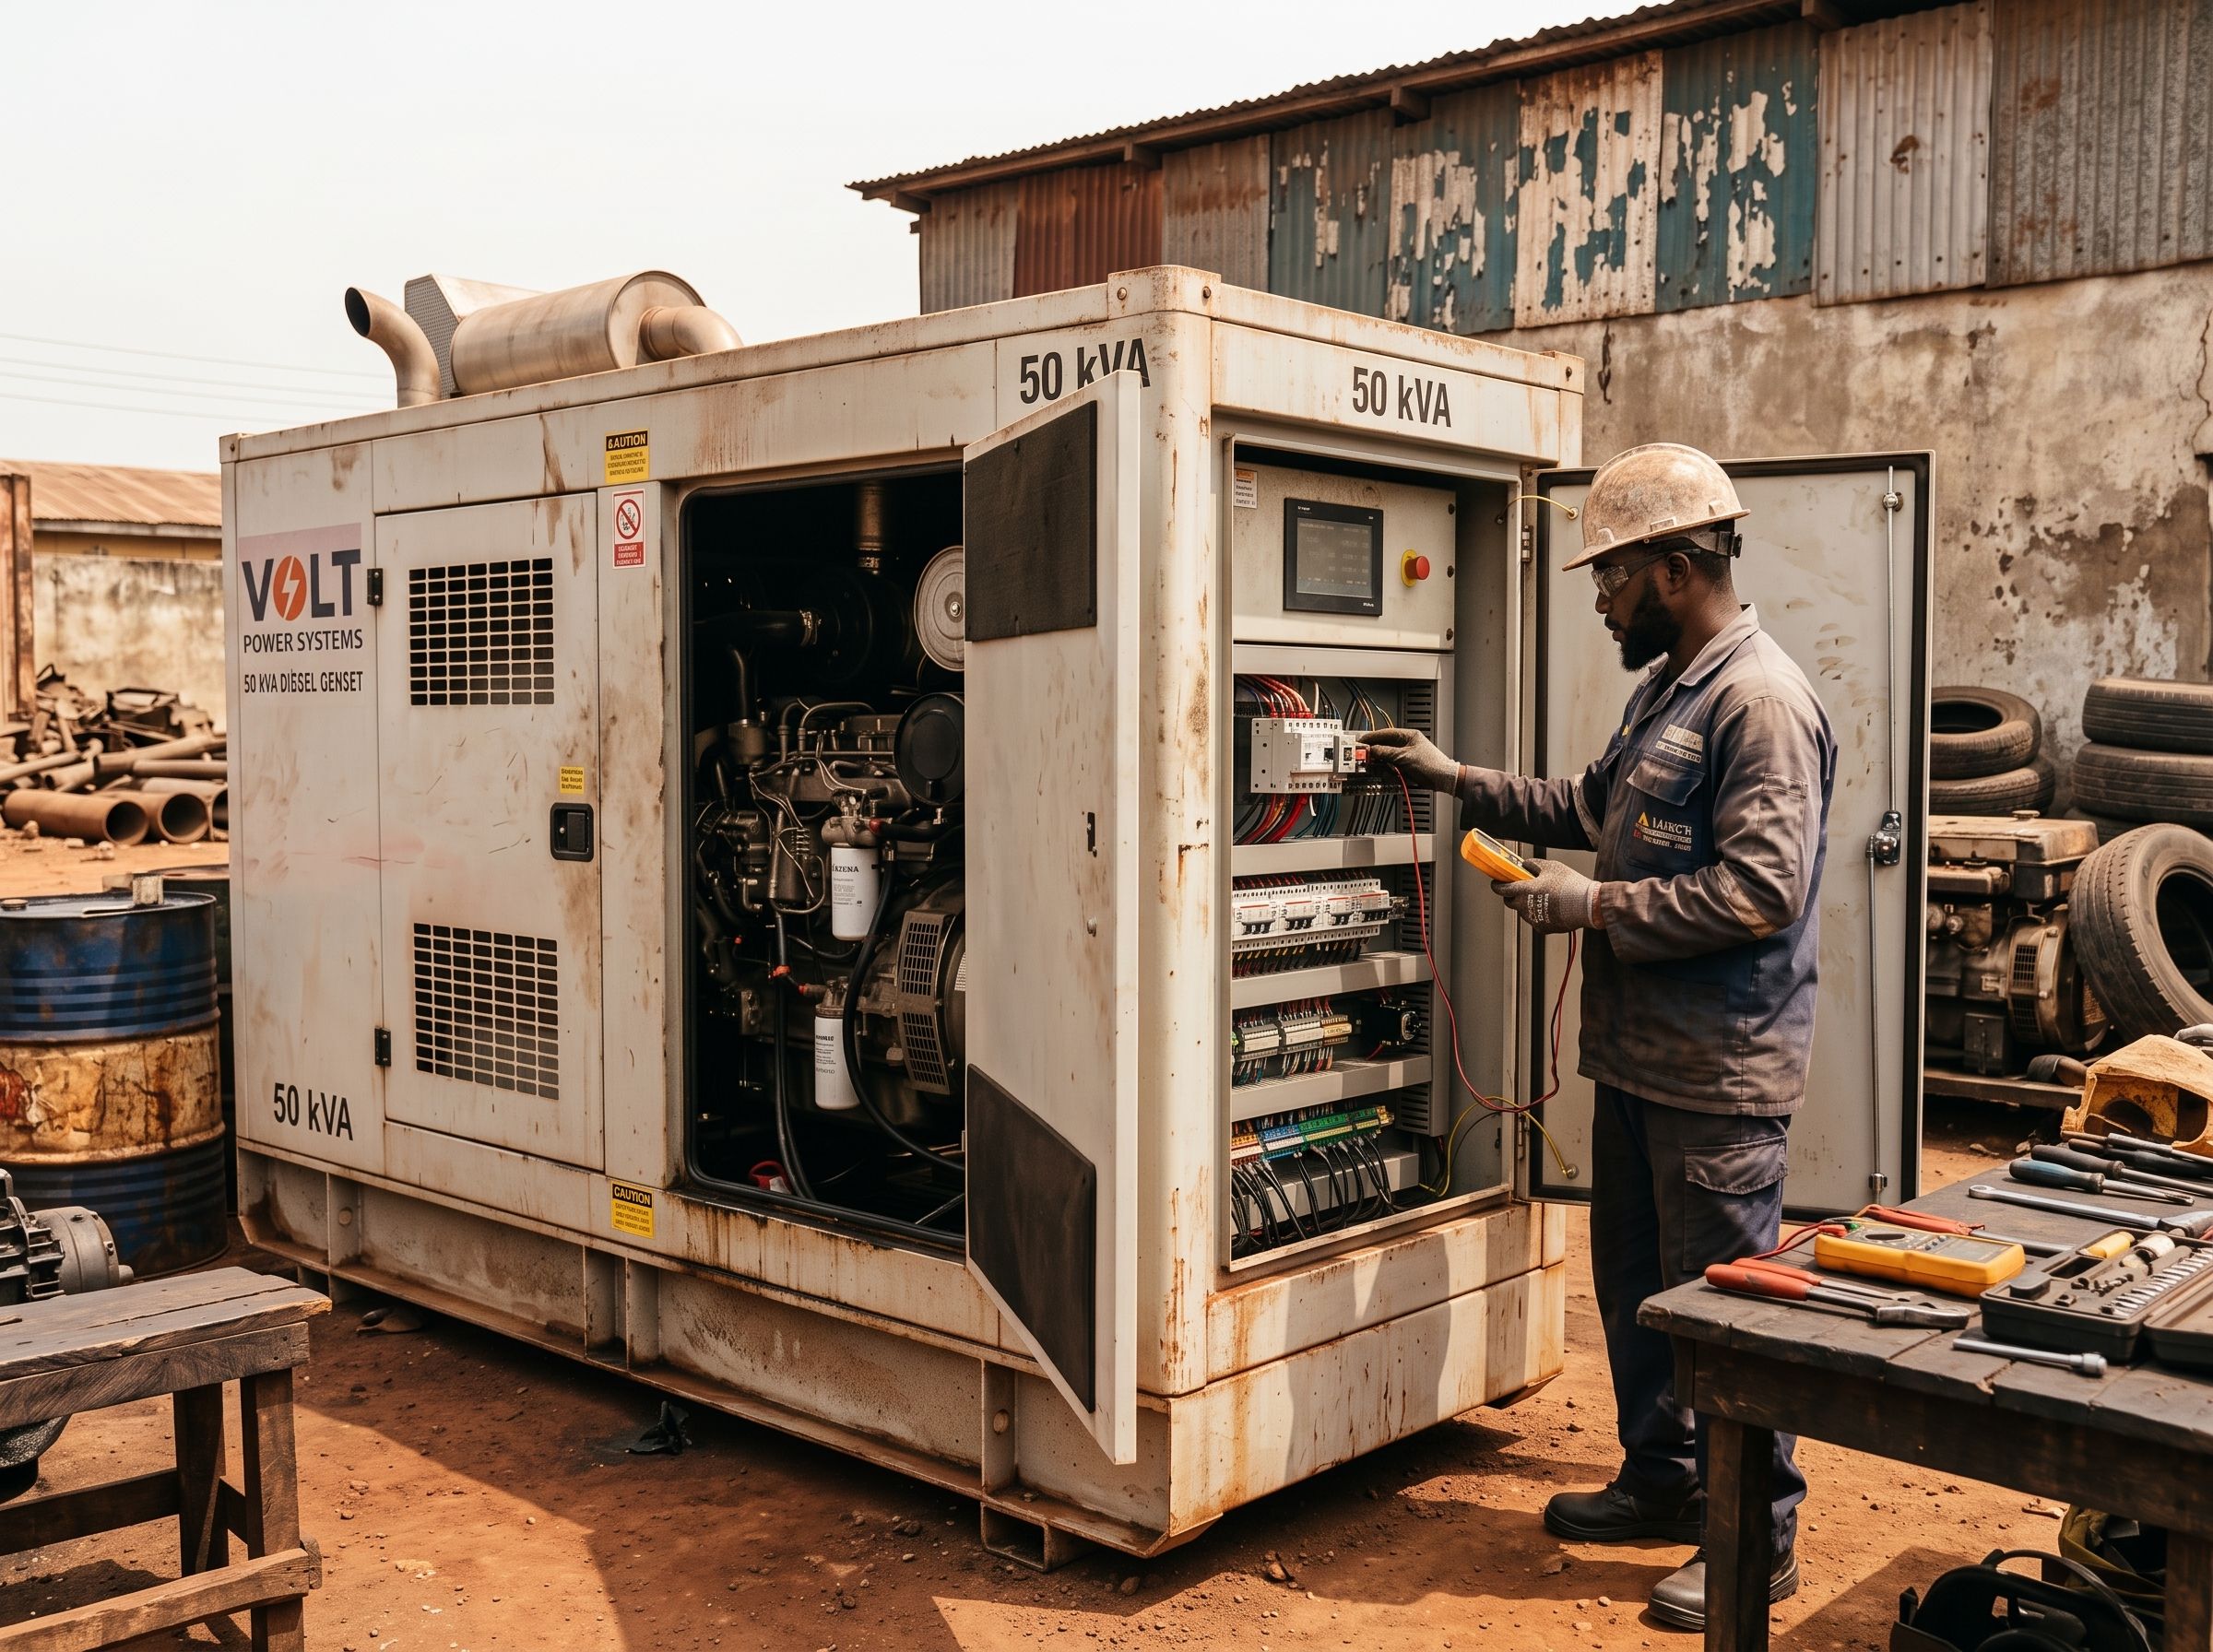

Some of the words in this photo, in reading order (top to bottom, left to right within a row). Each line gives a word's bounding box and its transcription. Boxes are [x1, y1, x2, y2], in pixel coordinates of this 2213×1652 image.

[1020, 351, 1063, 404] 50
[1077, 337, 1151, 389] kVA
[1352, 366, 1387, 417] 50
[1398, 374, 1451, 428] kVA
[242, 549, 361, 622] VOLT
[243, 632, 293, 654] POWER
[298, 629, 363, 652] SYSTEMS
[244, 674, 255, 693] 50
[259, 673, 278, 693] kVA
[320, 671, 363, 692] GENSET
[274, 1082, 300, 1127] 50
[308, 1089, 353, 1141] kVA
